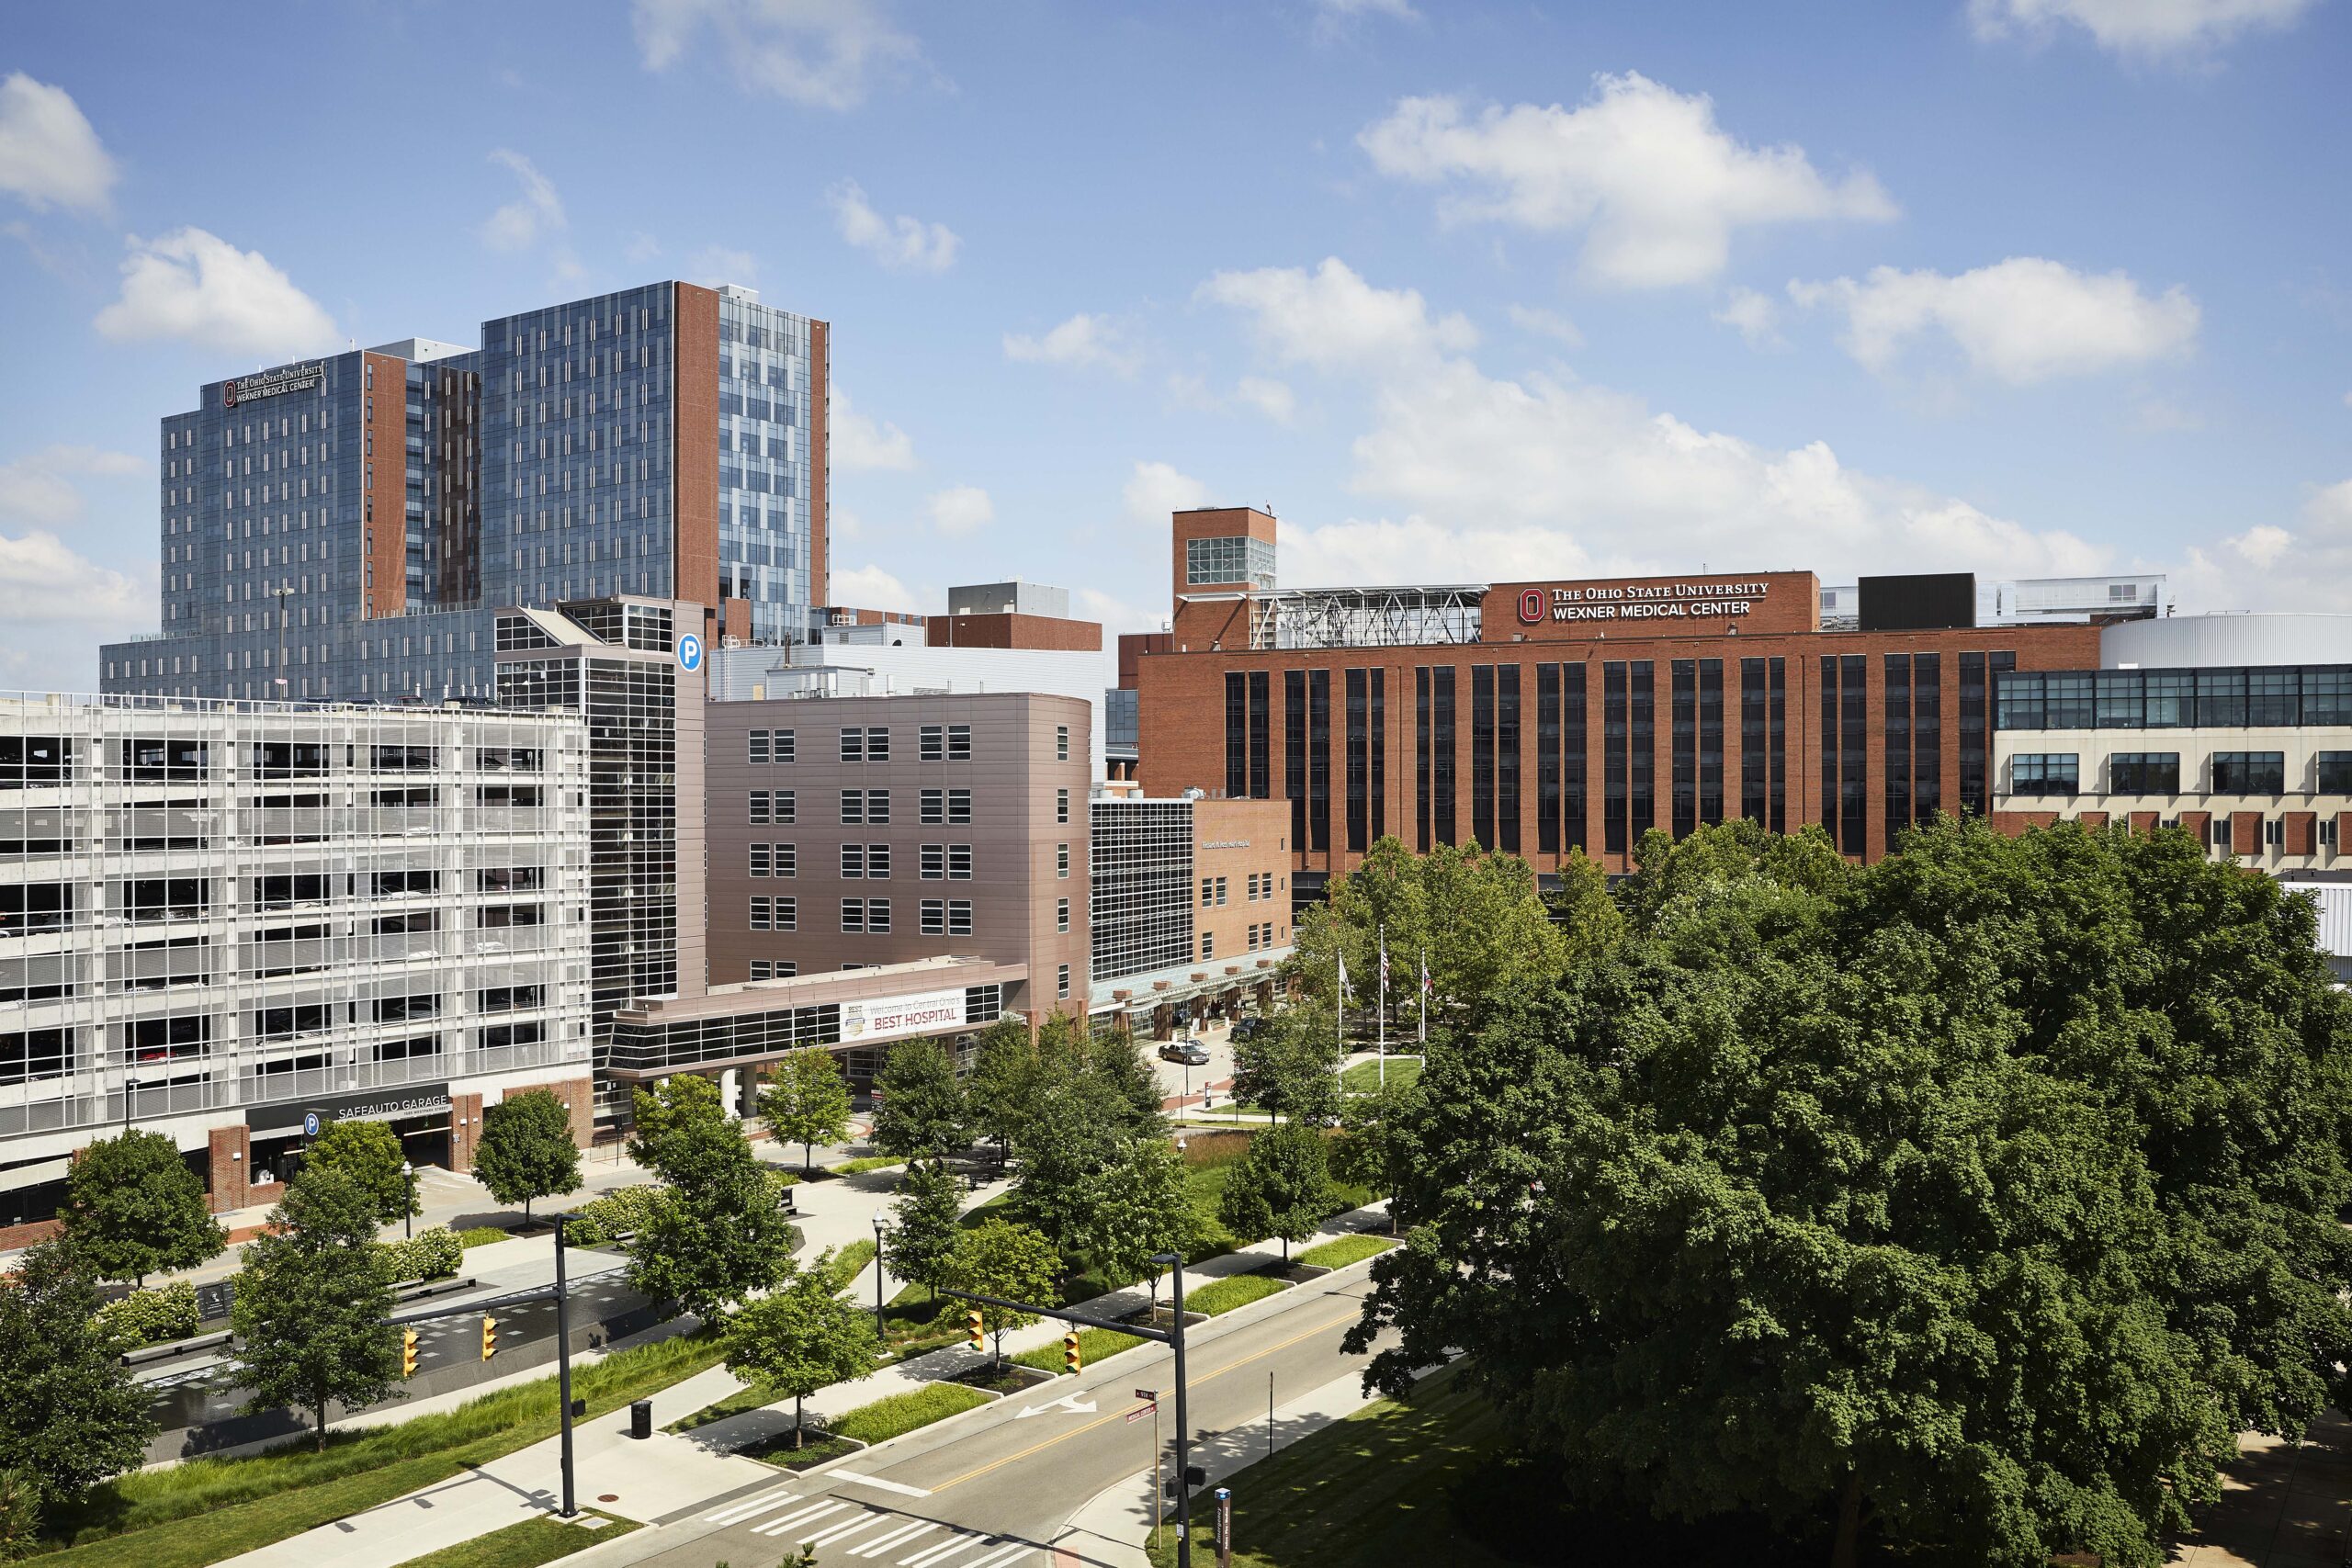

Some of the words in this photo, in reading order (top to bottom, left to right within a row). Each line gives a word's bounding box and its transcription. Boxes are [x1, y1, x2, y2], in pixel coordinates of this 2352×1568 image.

[266, 374, 284, 384] STATE
[285, 366, 323, 379] UNIVERSITY
[236, 389, 262, 402] WEXNER
[263, 385, 288, 397] MEDICAL
[289, 378, 314, 391] CENTER
[1553, 589, 1581, 601] THE
[1586, 587, 1623, 600] OHIO
[1627, 586, 1671, 598] STATE
[1675, 582, 1769, 596] UNIVERSITY
[1553, 607, 1615, 620] WEXNER
[1621, 604, 1687, 618] MEDICAL
[1690, 602, 1750, 615] CENTER
[684, 640, 697, 664] P
[870, 1005, 902, 1015] Welcome
[905, 1002, 912, 1010] to
[914, 998, 938, 1010] Central
[939, 996, 961, 1007] Ohio's
[875, 1015, 902, 1030] BEST
[905, 1008, 957, 1026] HOSPITAL
[338, 1101, 399, 1119] SAFEAUTO
[401, 1095, 447, 1110] GARAGE
